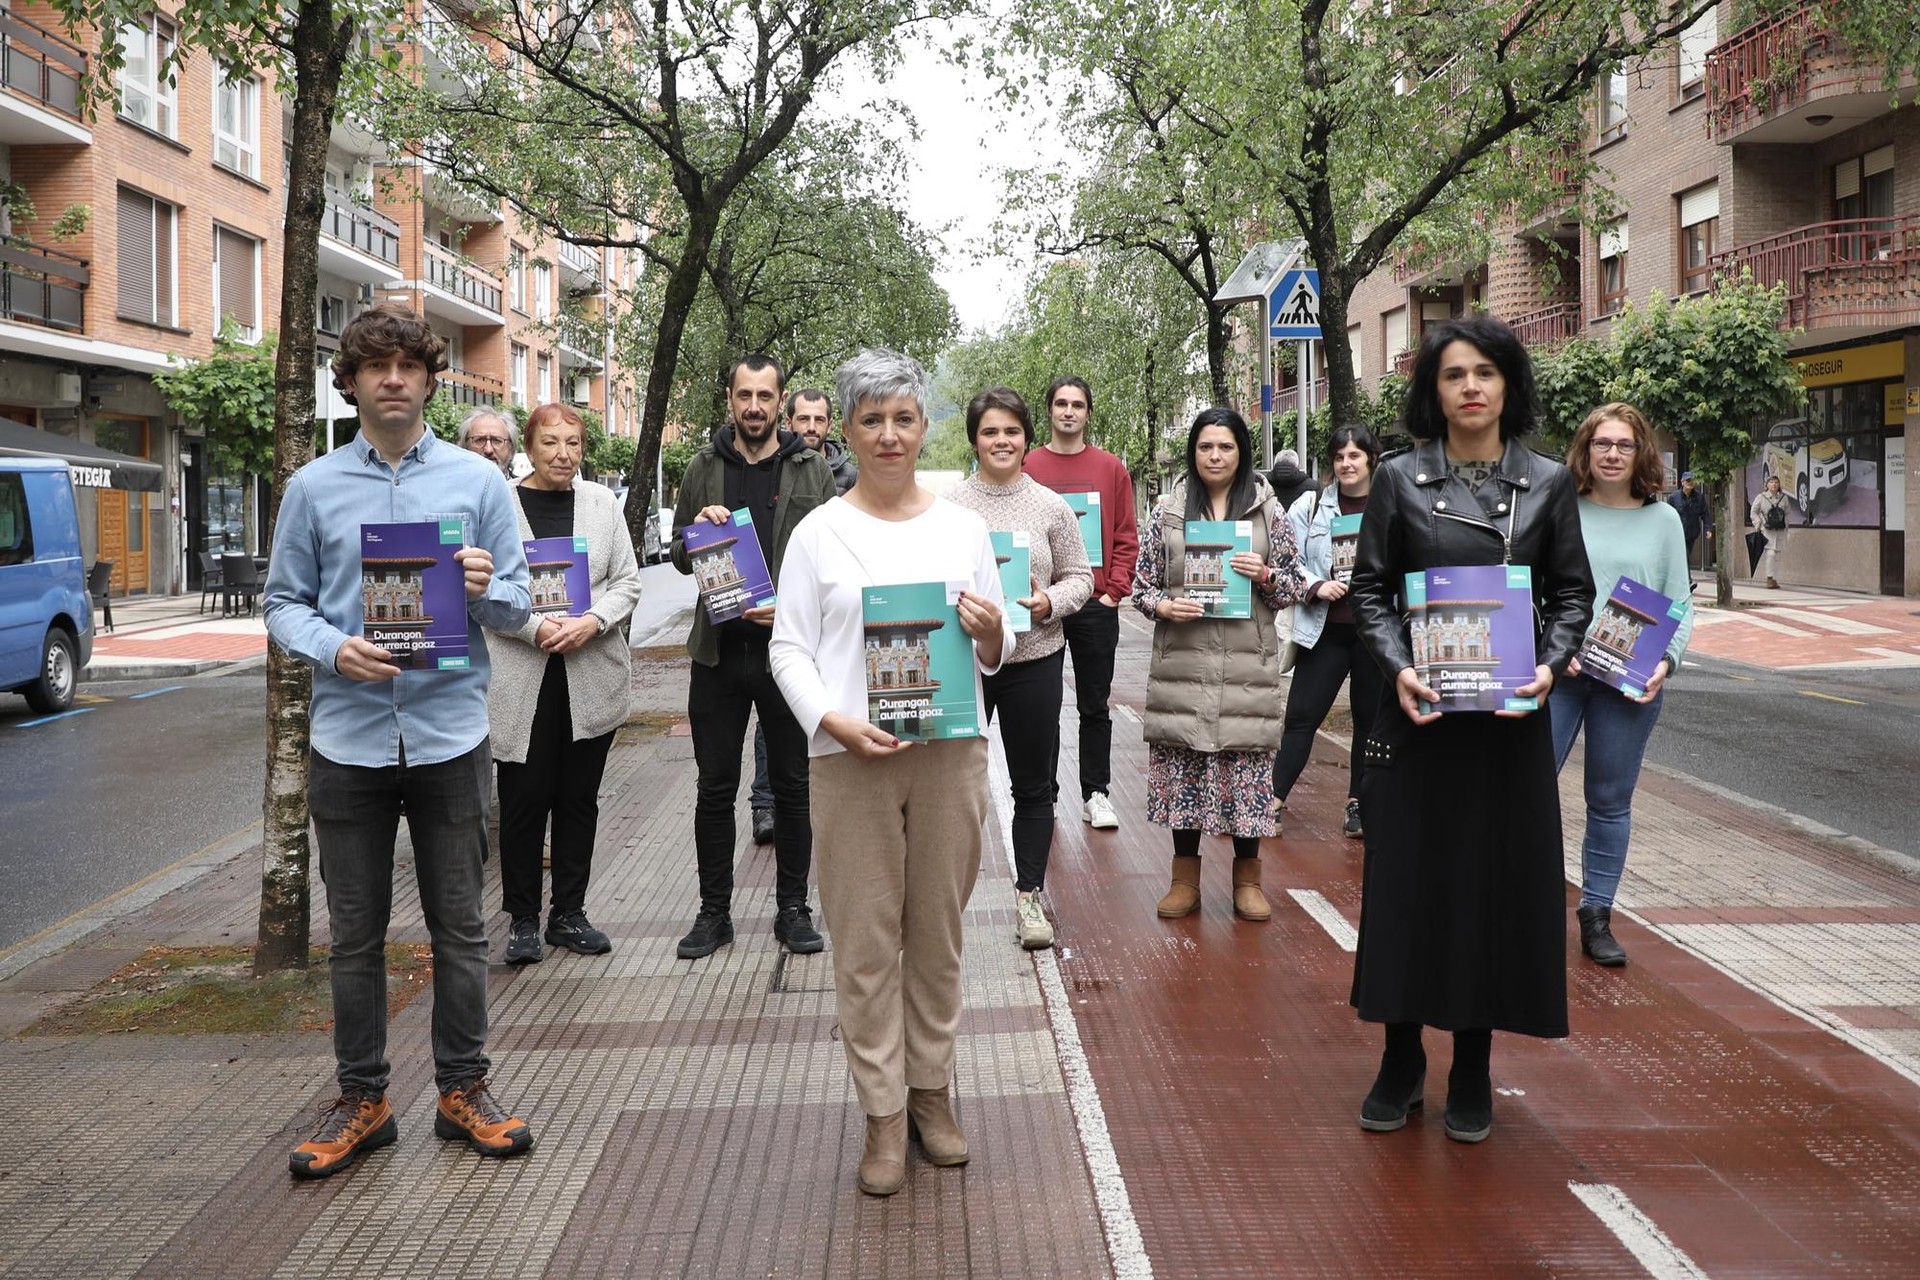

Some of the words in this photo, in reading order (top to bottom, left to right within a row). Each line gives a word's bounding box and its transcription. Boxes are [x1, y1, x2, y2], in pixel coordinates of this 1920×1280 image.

[373, 630, 422, 641] Durangon
[374, 641, 410, 650] aurrera
[411, 641, 436, 651] goaz
[1440, 670, 1489, 681] Durangon
[1441, 682, 1477, 690] aurrera
[1478, 681, 1502, 691] goaz
[879, 698, 929, 710] Durangon
[879, 709, 918, 720] aurrera
[918, 708, 944, 719] goaz
